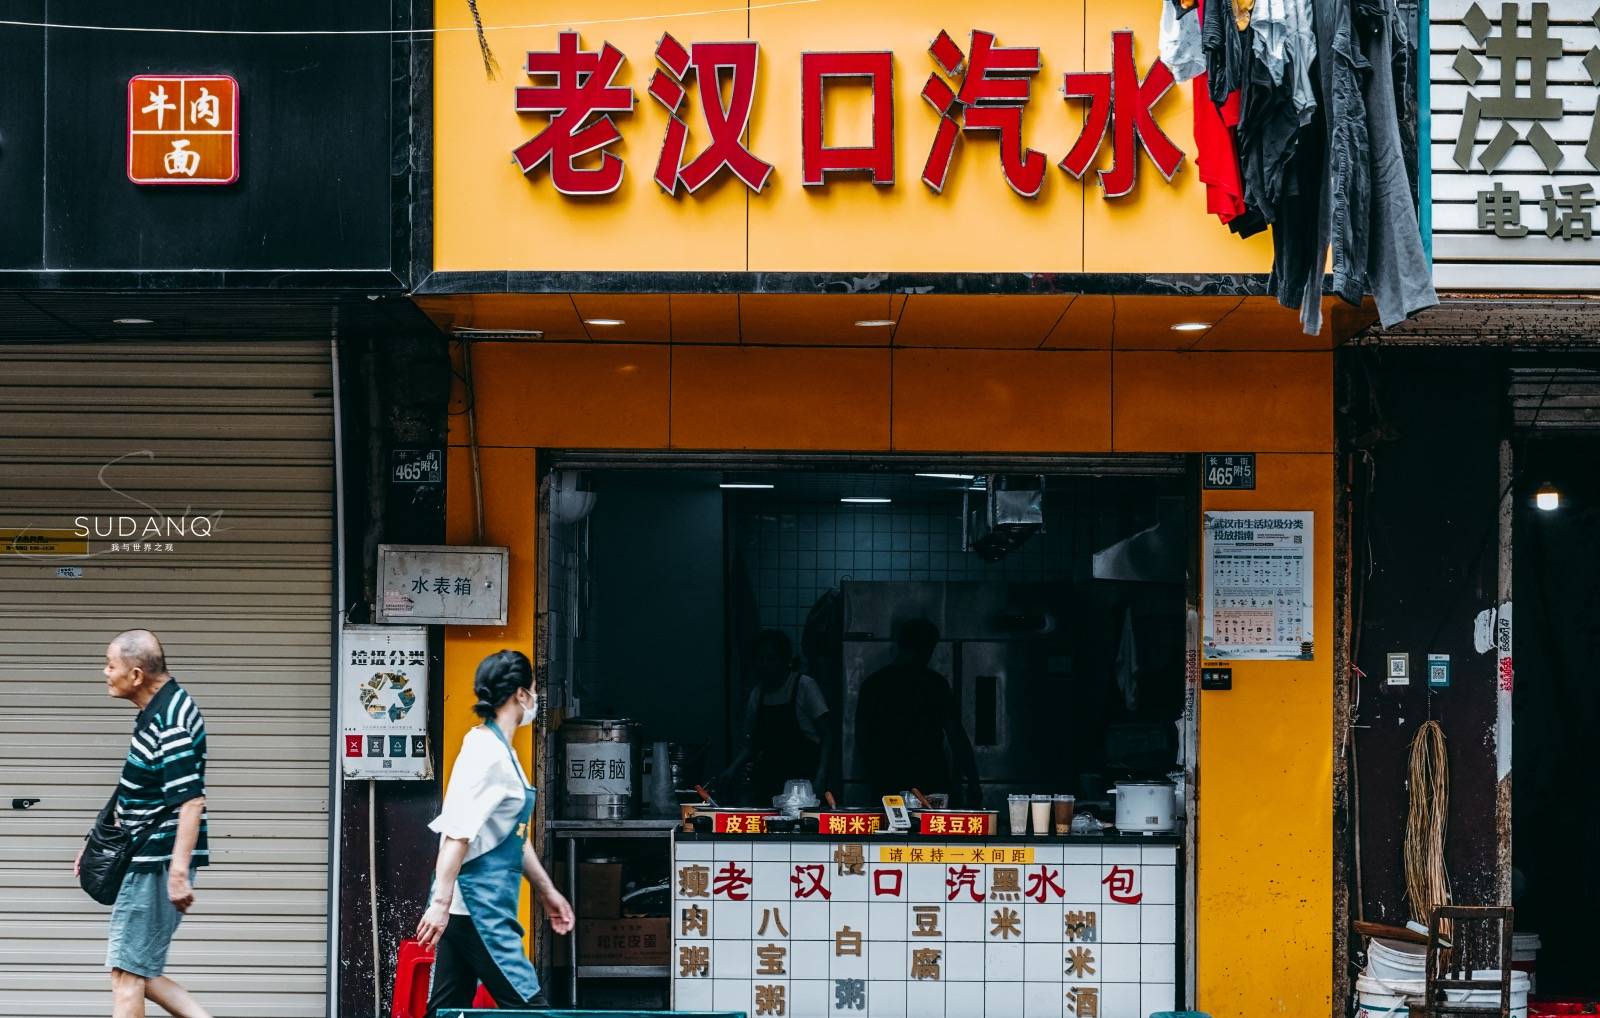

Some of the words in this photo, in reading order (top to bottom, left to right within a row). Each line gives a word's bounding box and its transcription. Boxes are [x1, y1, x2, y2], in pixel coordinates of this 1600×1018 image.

[140, 84, 220, 130] 牛肉
[511, 28, 1187, 199] 老汉口汽水
[163, 139, 201, 177] 面
[1477, 182, 1597, 240] 电话
[1214, 519, 1304, 530] 武汉市生活垃圾分类
[1214, 531, 1254, 541] 投放指南
[411, 576, 472, 596] 水表箱
[570, 758, 627, 781] 豆腐脑
[725, 815, 768, 834] 皮蛋
[828, 815, 881, 834] 糊米酒
[929, 815, 983, 834] 绿豆粥
[889, 848, 1027, 863] 请保持一米间距
[712, 861, 1143, 905] 老汉口汽水包
[989, 867, 1022, 940] 黑米
[678, 863, 711, 977] 瘦肉粥
[755, 907, 789, 1016] 八宝粥
[911, 905, 943, 980] 豆腐
[1063, 910, 1099, 1018] 糊米酒
